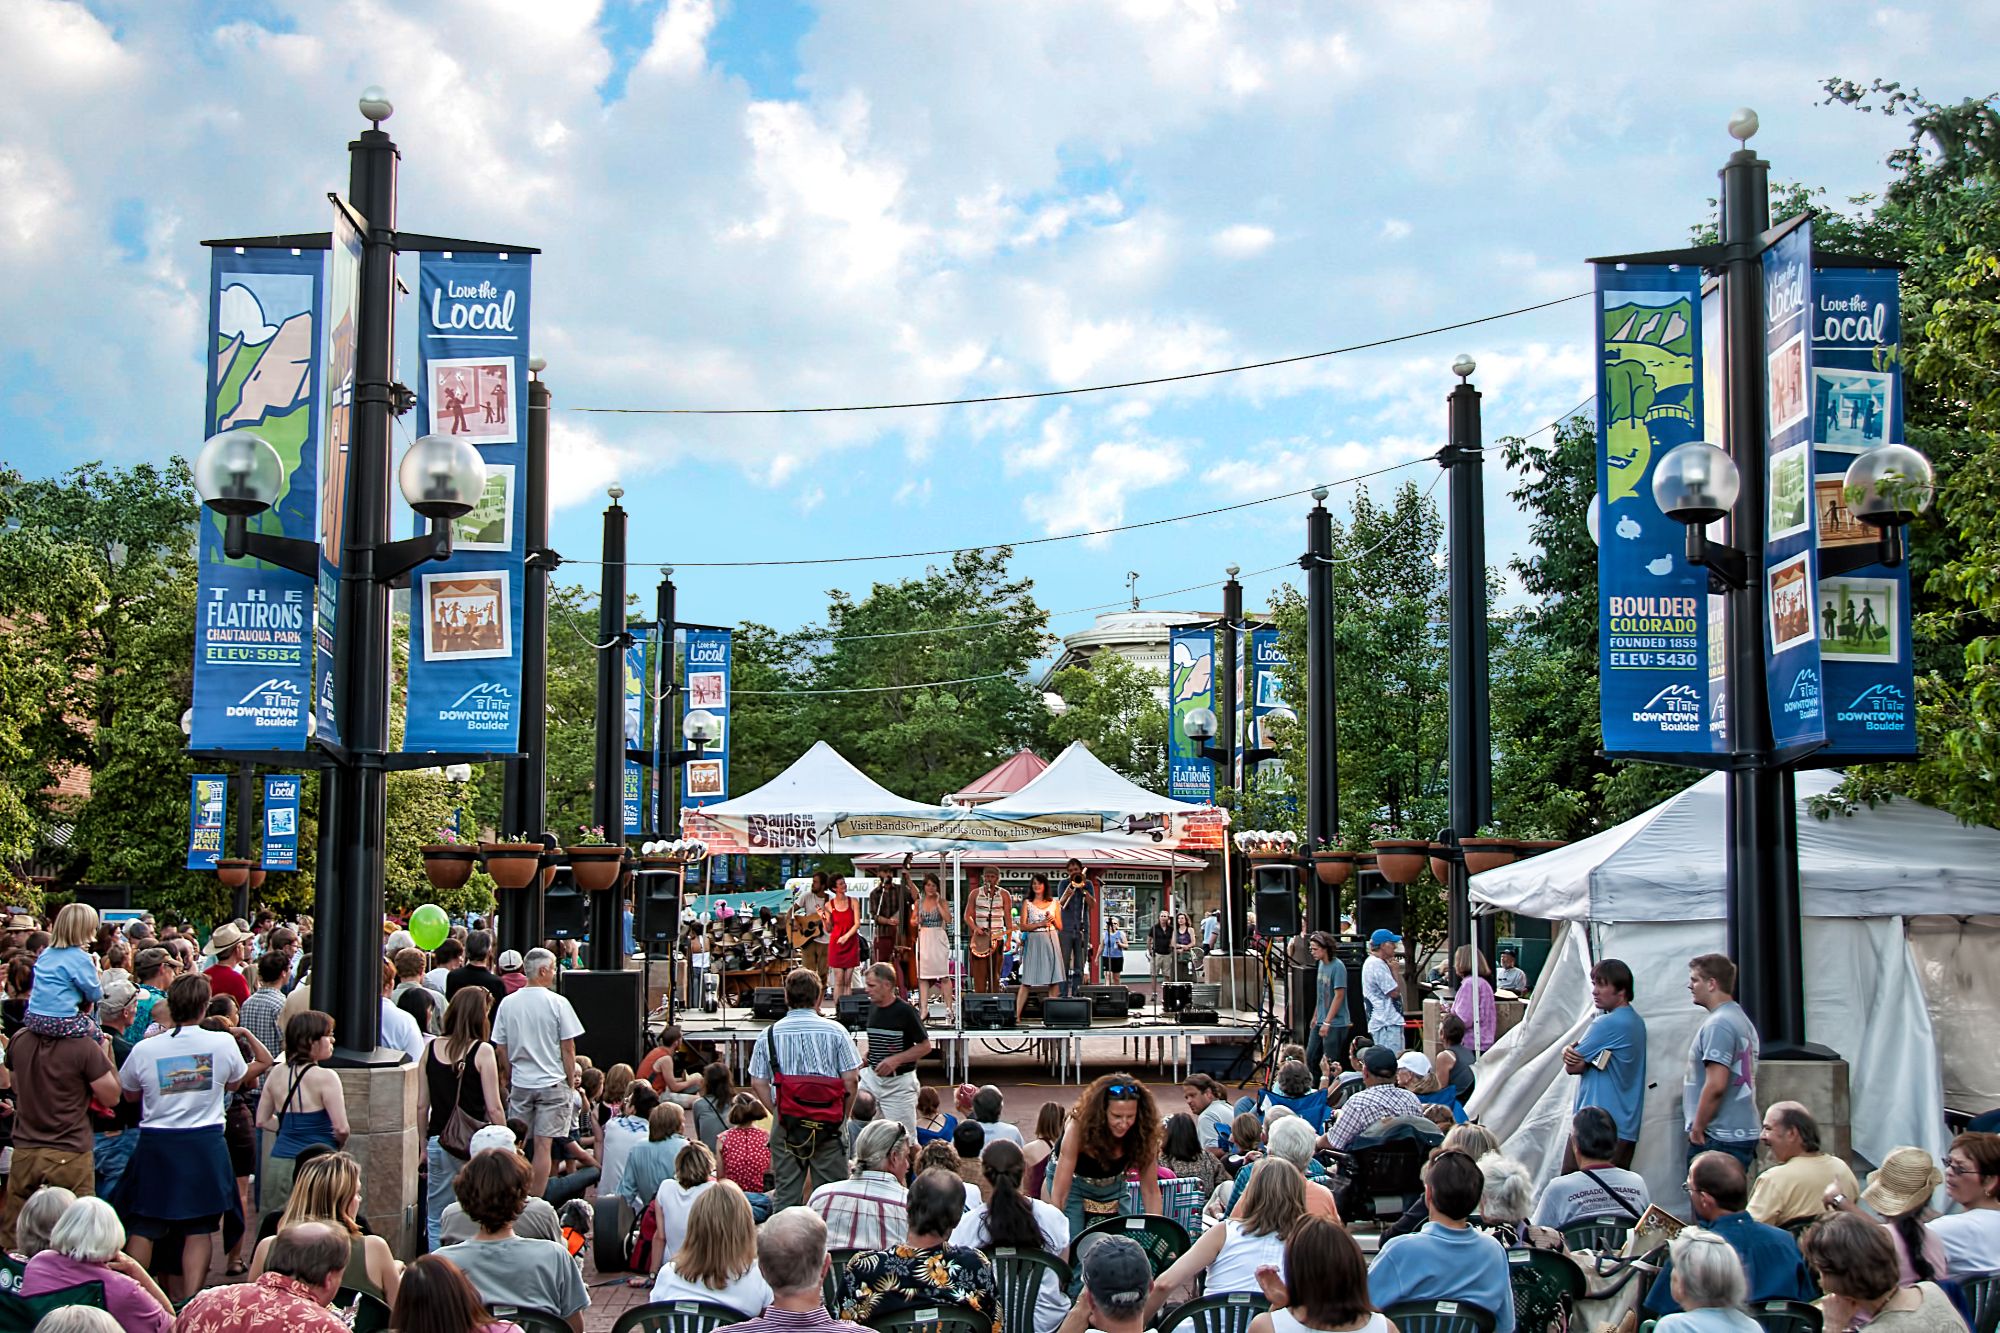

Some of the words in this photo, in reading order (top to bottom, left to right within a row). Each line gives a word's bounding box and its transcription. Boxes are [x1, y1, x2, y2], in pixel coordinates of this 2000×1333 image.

[1774, 271, 1787, 288] Love
[449, 280, 478, 298] Love
[477, 280, 497, 299] the
[1769, 262, 1804, 322] Local
[432, 288, 516, 332] Local
[1821, 294, 1849, 312] Love
[1848, 294, 1867, 312] the
[1810, 302, 1885, 343] Local
[209, 588, 303, 602] THE
[1609, 596, 1697, 617] BOULDER
[207, 601, 303, 629] FLATIRONS
[1609, 617, 1697, 632] COLORADO
[207, 628, 272, 642] CHAUTAUQUA
[274, 631, 302, 643] PARK
[1609, 637, 1666, 648] FOUNDED
[1669, 638, 1697, 648] 1859
[207, 647, 254, 660] ELEV:
[257, 648, 301, 661] 5934
[691, 644, 725, 662] Local
[1257, 643, 1288, 661] Loca
[1610, 653, 1654, 666] ELEV:
[1656, 653, 1698, 666] 5430
[226, 706, 298, 717] DOWNTOWN
[1784, 697, 1818, 712] DOWNTOWN
[439, 710, 509, 721] DOWNTOWN
[1632, 712, 1699, 722] DOWNTOWN
[1799, 708, 1818, 719] Boulder
[1837, 712, 1904, 721] DOWNTOWN
[255, 717, 299, 727] Boulder
[468, 720, 510, 730] Boulder
[1660, 722, 1700, 731] Boulder
[1866, 721, 1905, 730] Boulder
[1173, 771, 1211, 782] FLATIRONS
[270, 783, 295, 797] Local
[850, 820, 873, 831] Visit
[875, 819, 991, 836] BandsOnTheBricks.com
[994, 827, 1007, 837] for
[1010, 827, 1029, 836] this
[1031, 823, 1059, 838] year's
[1061, 817, 1094, 831] lineup!
[194, 831, 221, 839] PEARL
[1104, 871, 1159, 881] information
[1568, 1188, 1603, 1202] COLORADO
